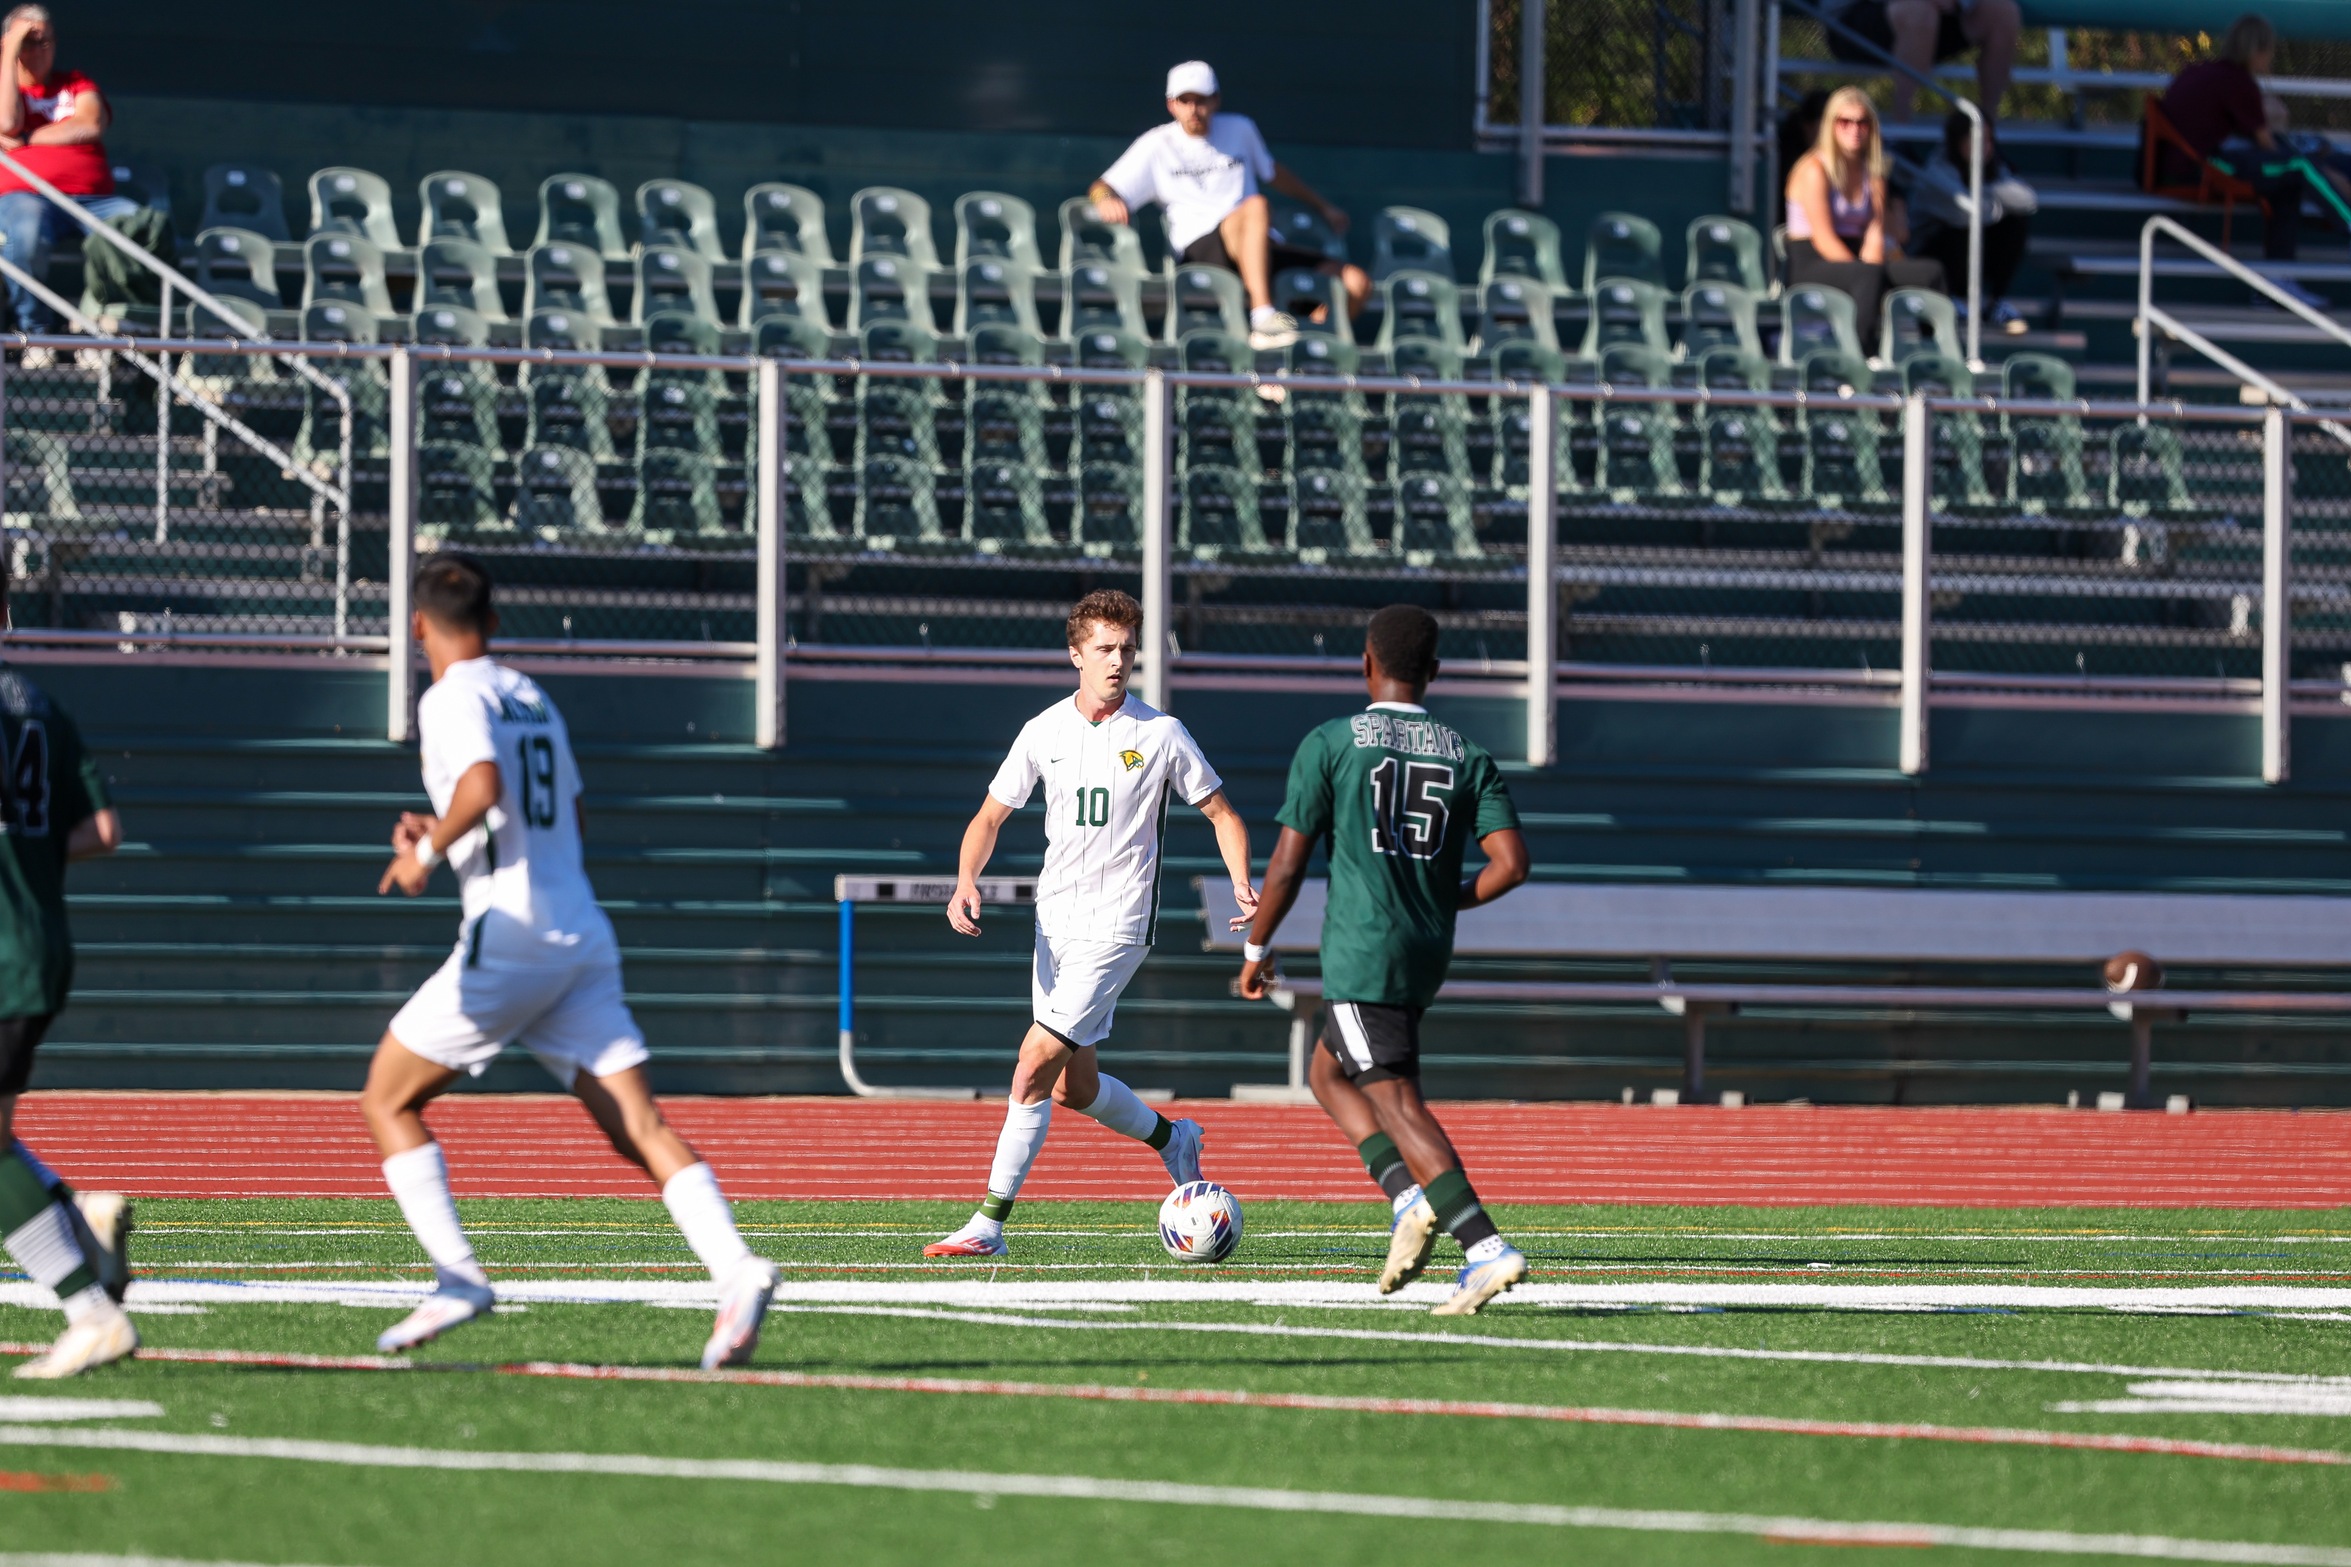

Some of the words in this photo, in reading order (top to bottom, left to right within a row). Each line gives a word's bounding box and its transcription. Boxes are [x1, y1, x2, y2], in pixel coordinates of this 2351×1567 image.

[1351, 713, 1464, 763] SPARTANS
[1076, 787, 1109, 827] 10
[1370, 756, 1454, 860] 15
